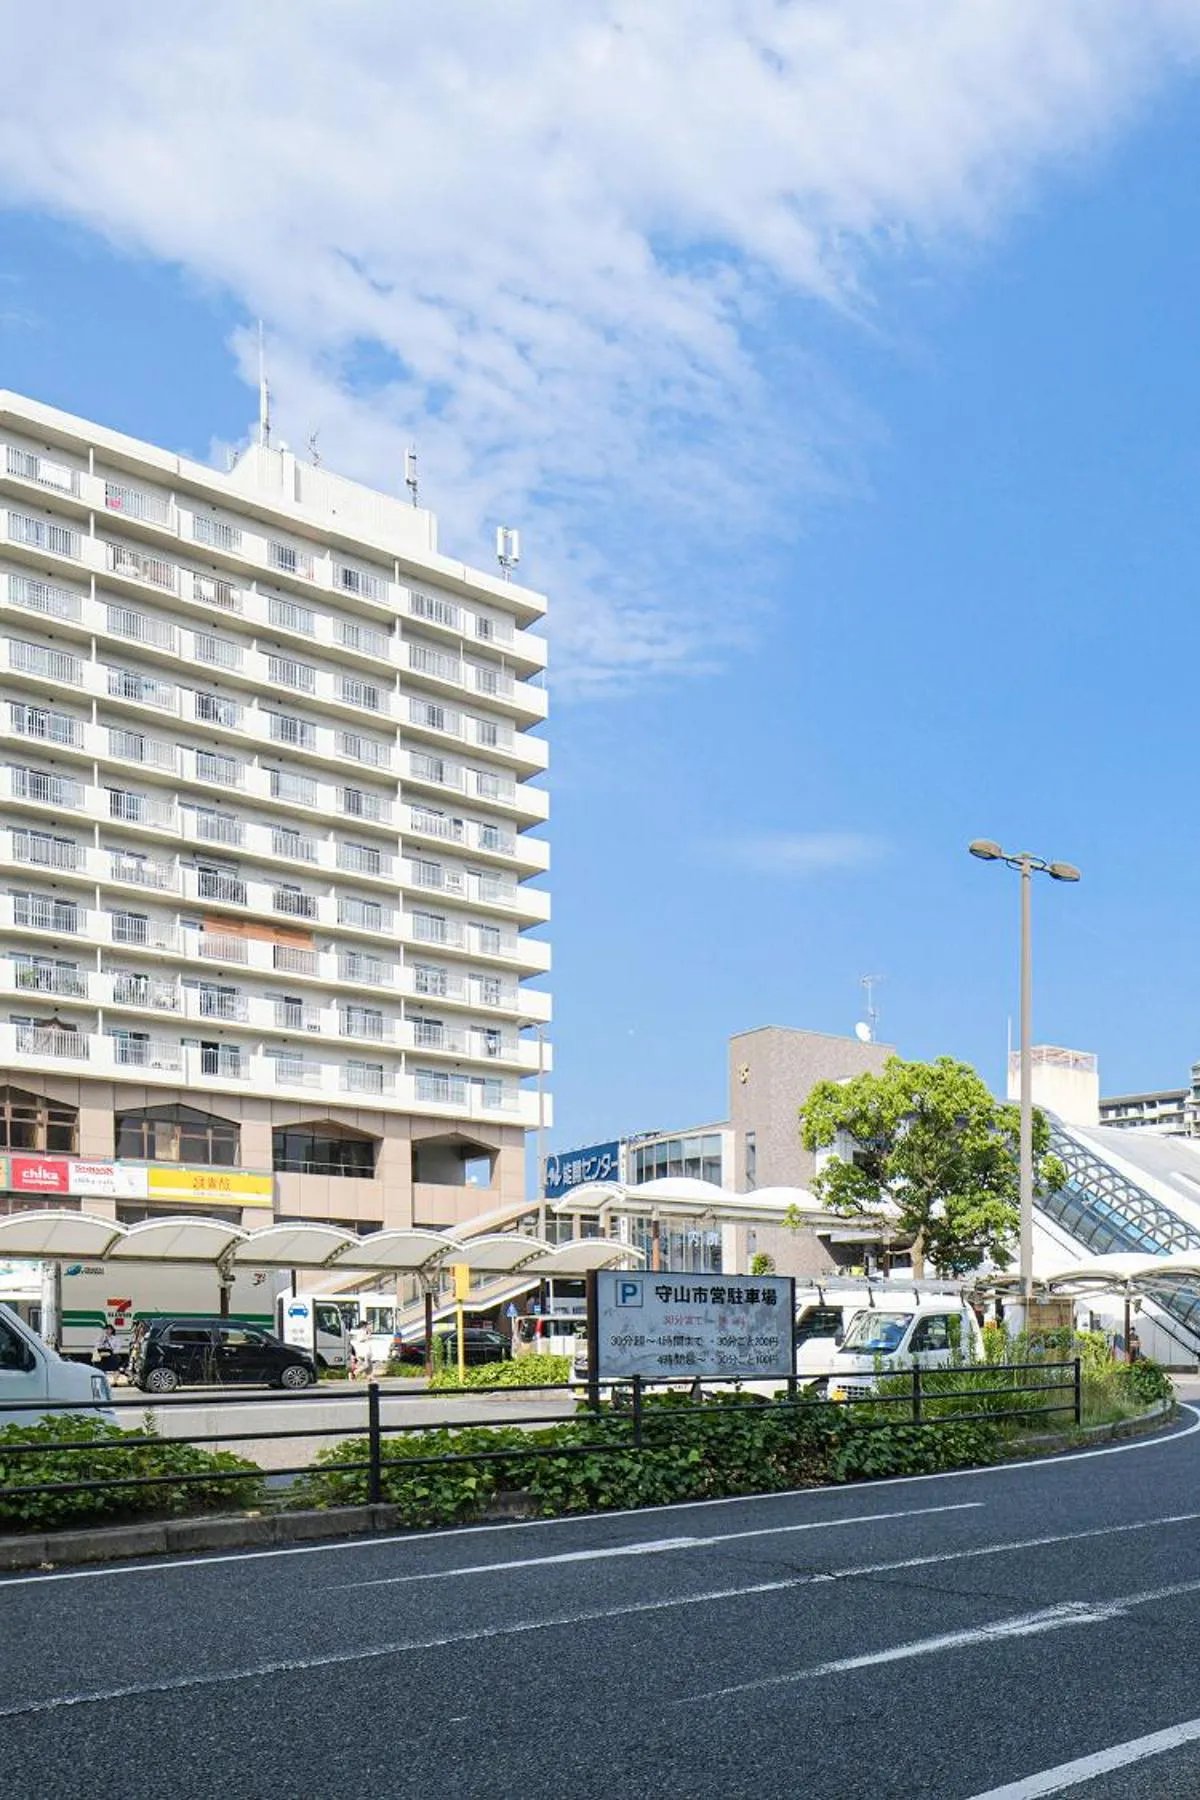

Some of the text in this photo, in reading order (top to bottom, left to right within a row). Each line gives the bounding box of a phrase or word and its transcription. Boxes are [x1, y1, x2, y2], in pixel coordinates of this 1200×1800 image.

[621, 1283, 638, 1304] P
[655, 1284, 777, 1306] 守山市営駐車場
